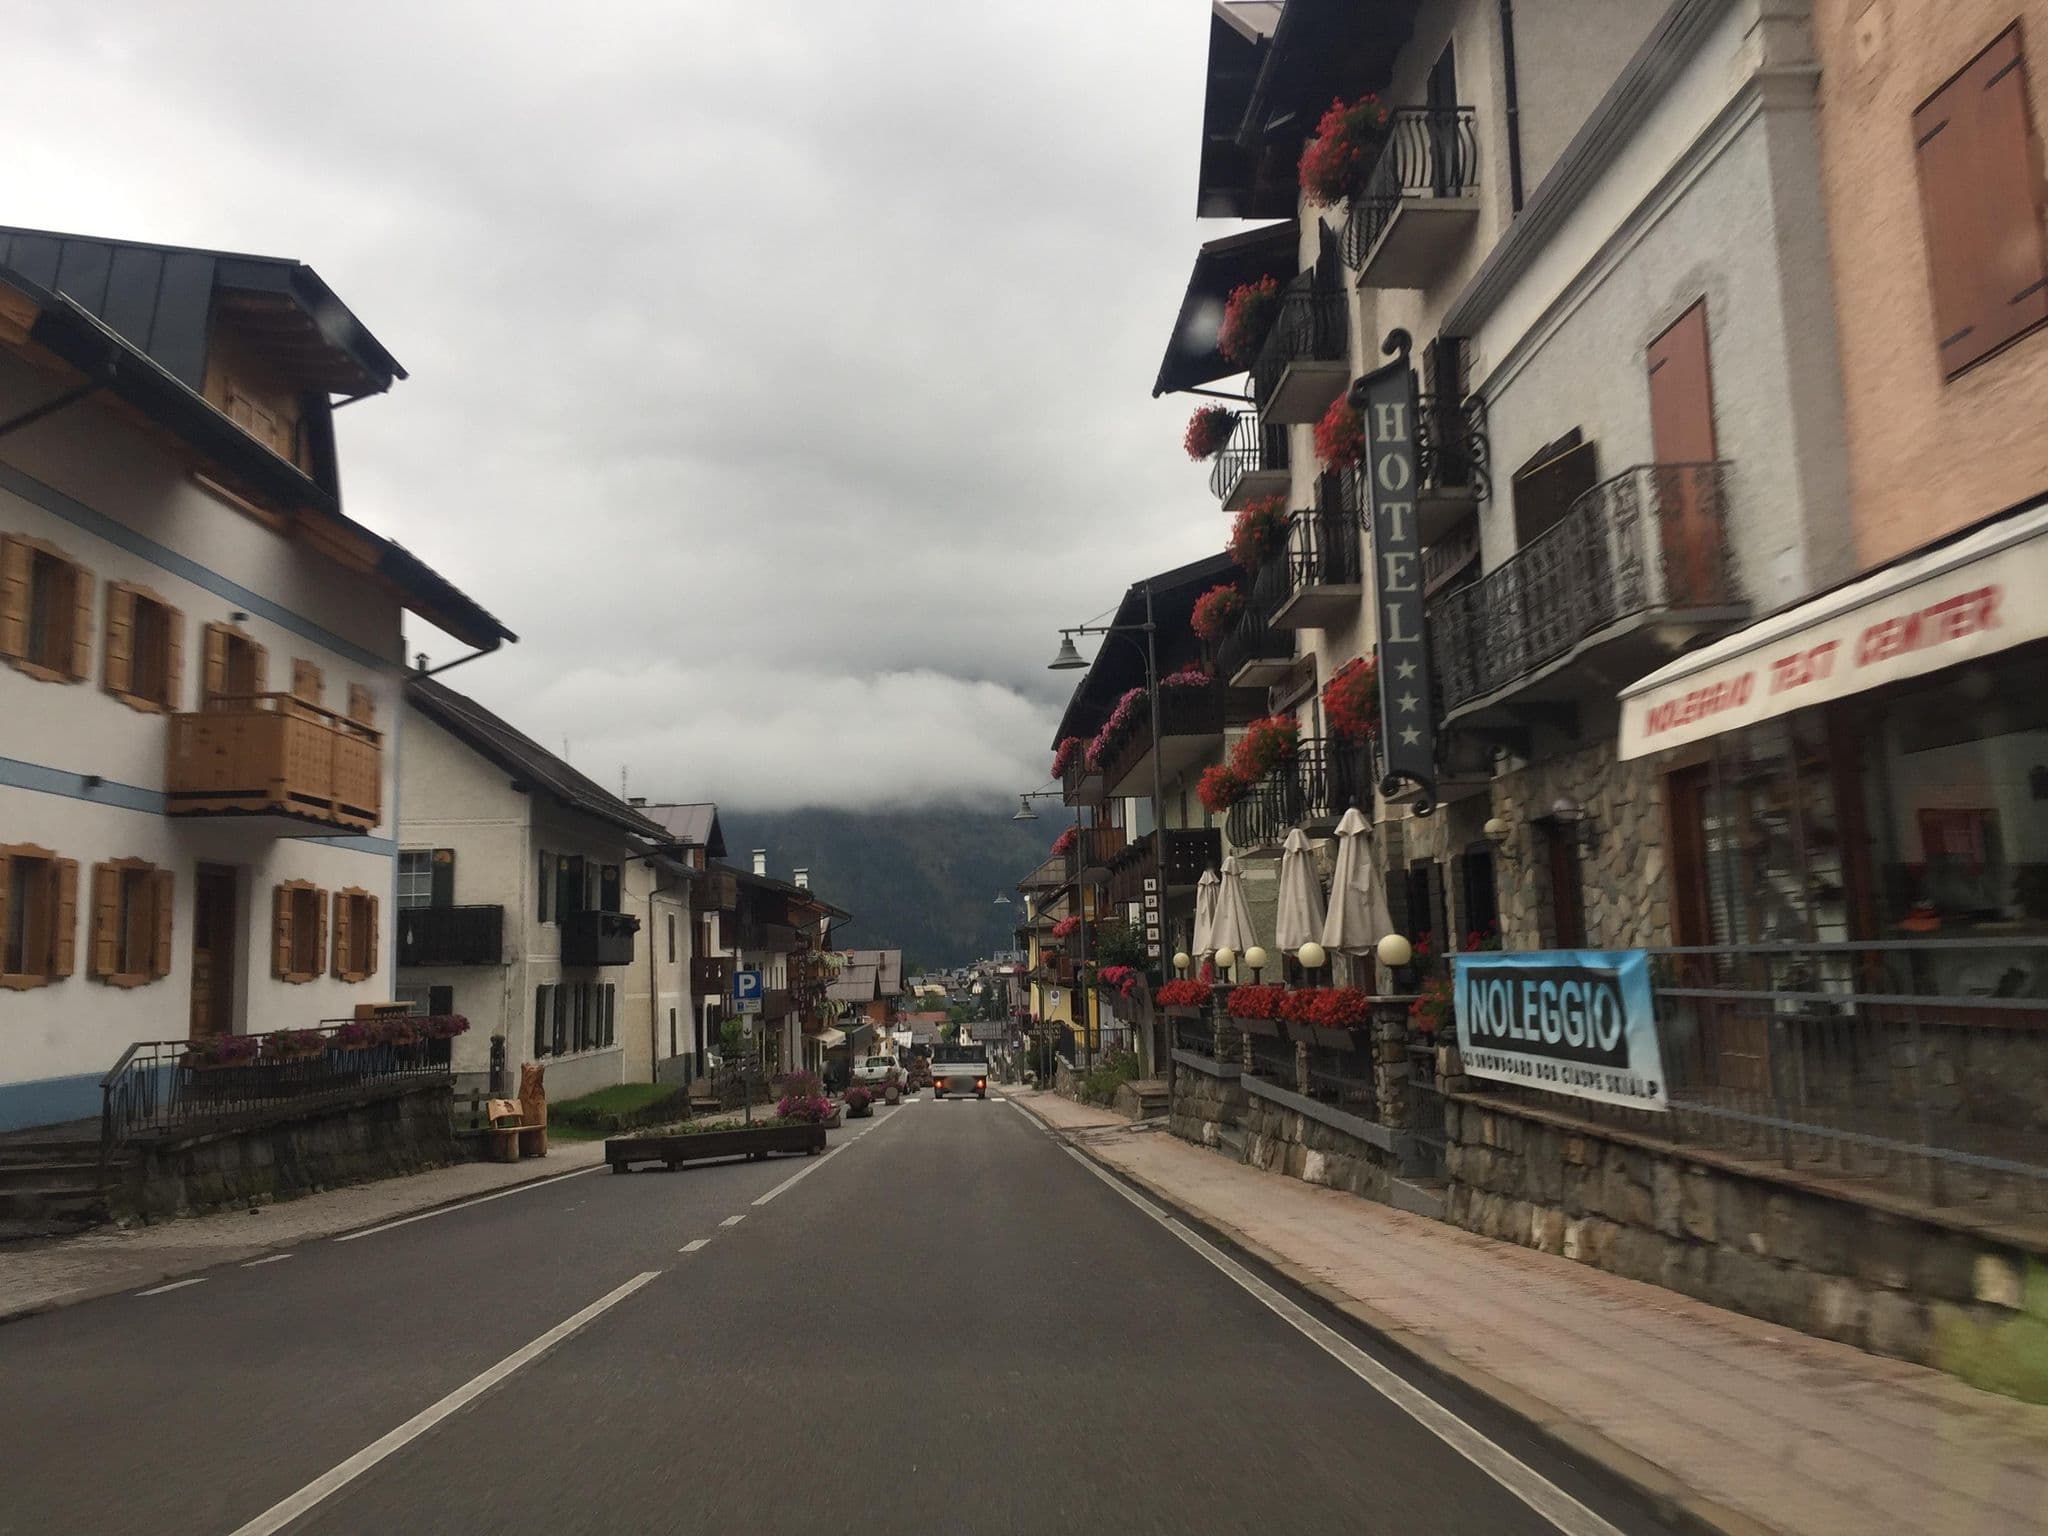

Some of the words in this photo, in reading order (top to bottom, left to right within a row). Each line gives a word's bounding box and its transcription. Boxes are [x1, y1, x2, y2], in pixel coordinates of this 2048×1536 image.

[1374, 402, 1420, 643] HOTEL
[1769, 639, 1843, 695] TEST
[1854, 583, 2004, 668] CENTER
[738, 974, 757, 997] P
[1470, 978, 1622, 1052] NOLEGGIO
